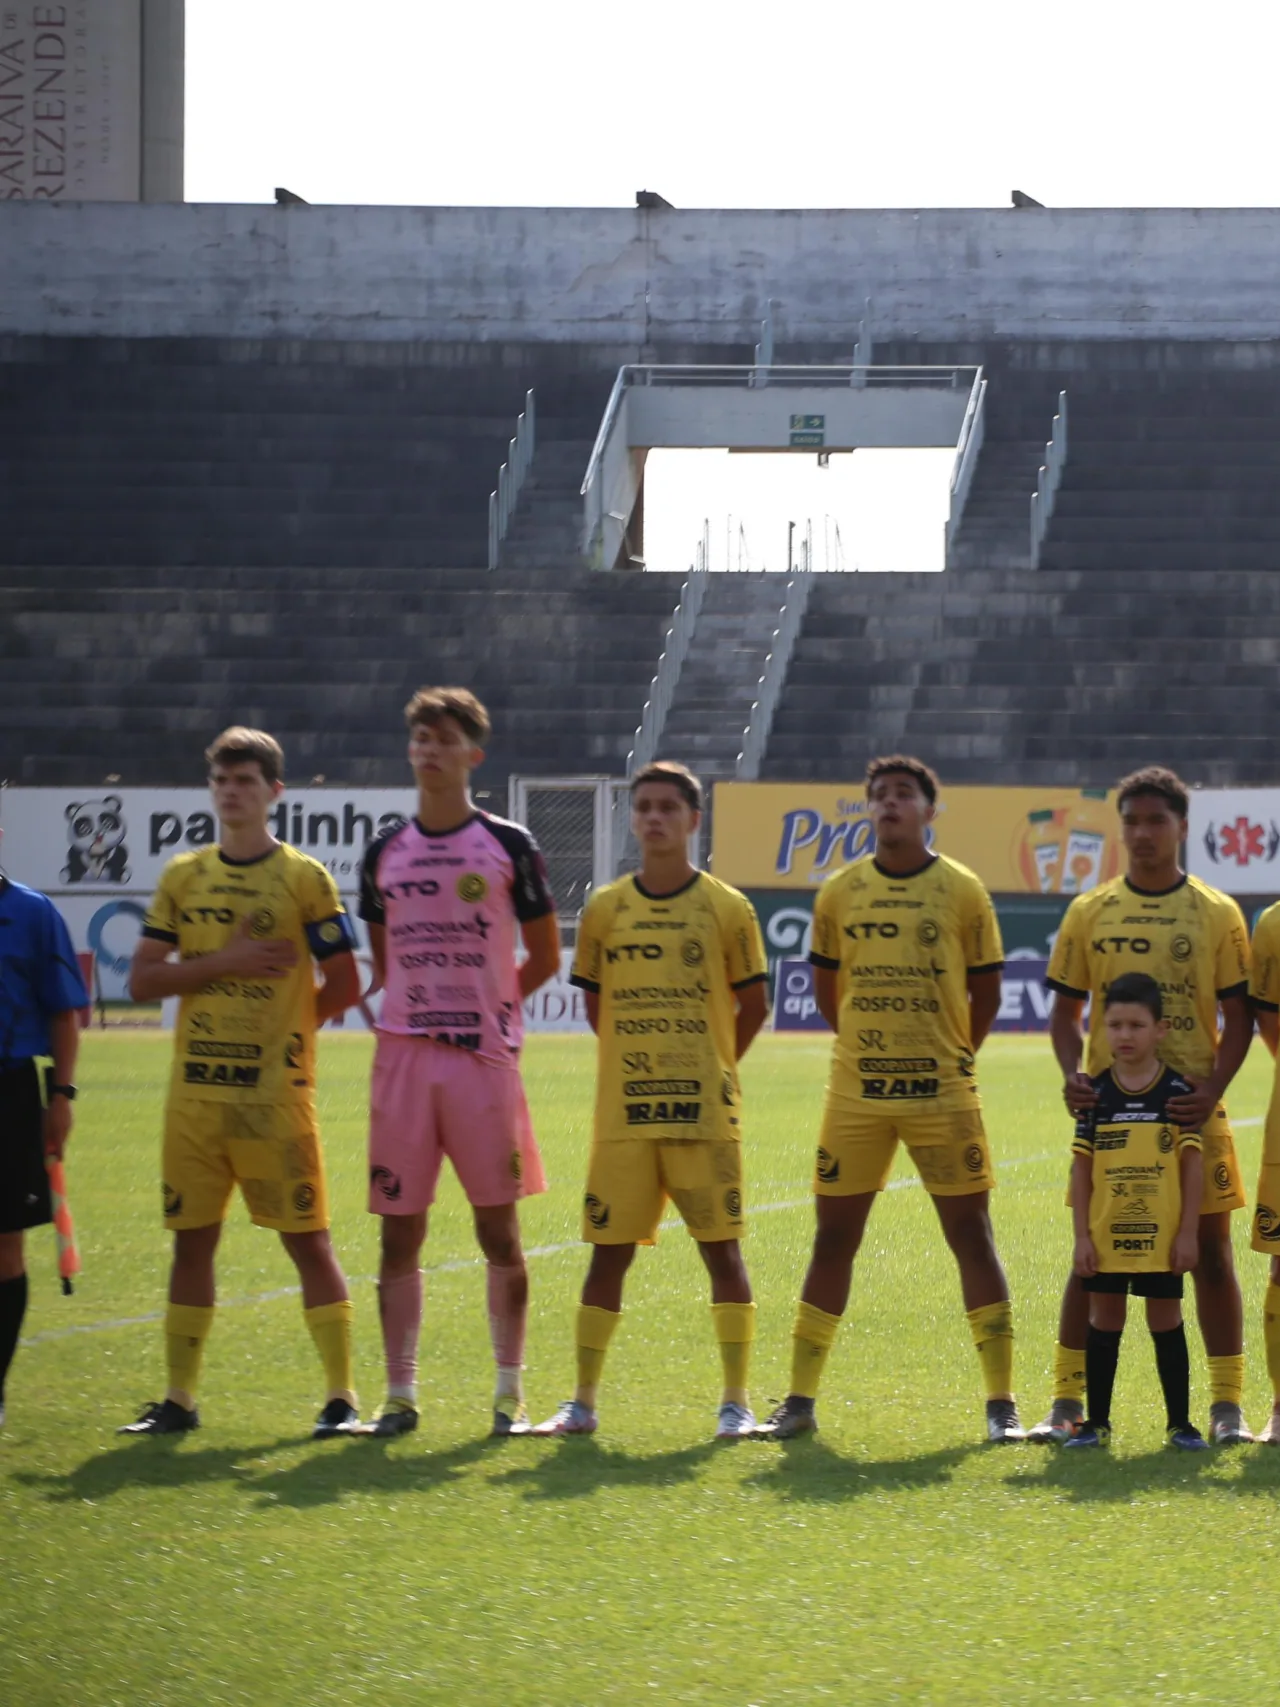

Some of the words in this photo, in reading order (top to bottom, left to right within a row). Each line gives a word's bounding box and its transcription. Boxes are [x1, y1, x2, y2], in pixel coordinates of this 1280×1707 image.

[844, 922, 899, 940] KTO
[606, 944, 663, 964] KTO
[1091, 937, 1151, 955] KTO
[852, 996, 906, 1013] FOSFO
[615, 1018, 670, 1036] FOSFO
[674, 1019, 707, 1035] 500
